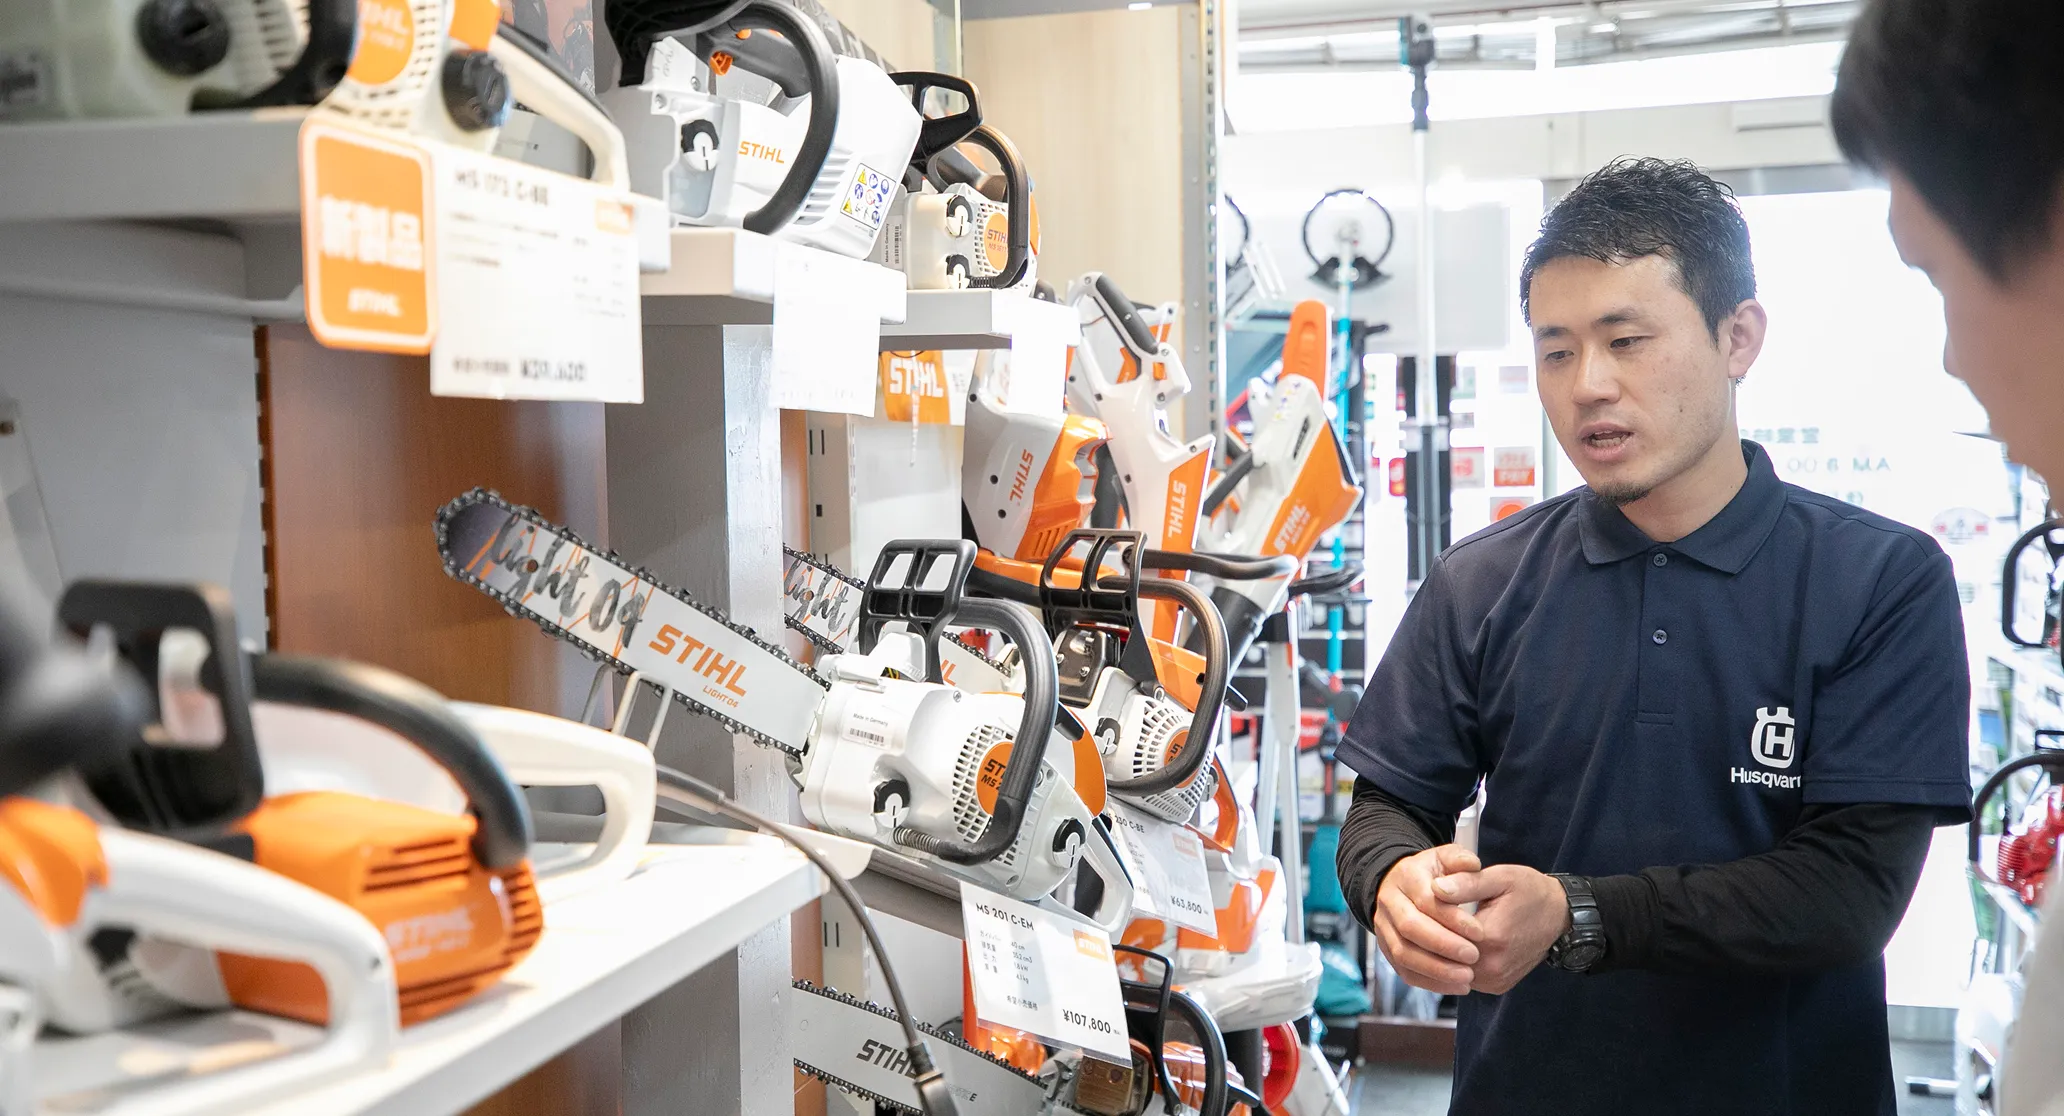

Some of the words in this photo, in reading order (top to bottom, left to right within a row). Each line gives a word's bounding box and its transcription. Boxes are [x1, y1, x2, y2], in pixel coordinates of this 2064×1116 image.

[738, 141, 785, 164] STIHL
[987, 229, 1008, 243] STIH
[889, 357, 944, 398] STIHL
[1009, 449, 1034, 501] STIHL
[1168, 480, 1187, 539] STIHL
[1274, 504, 1307, 553] STIHL
[485, 513, 590, 618] light
[649, 623, 747, 697] STIHL
[1115, 815, 1128, 827] 230
[1129, 820, 1145, 834] C-BE
[976, 903, 990, 915] MS
[992, 908, 1009, 923] 201
[1011, 914, 1034, 931] C-EM
[1170, 895, 1202, 914] ¥63,800
[1062, 1009, 1111, 1034] ¥107,800
